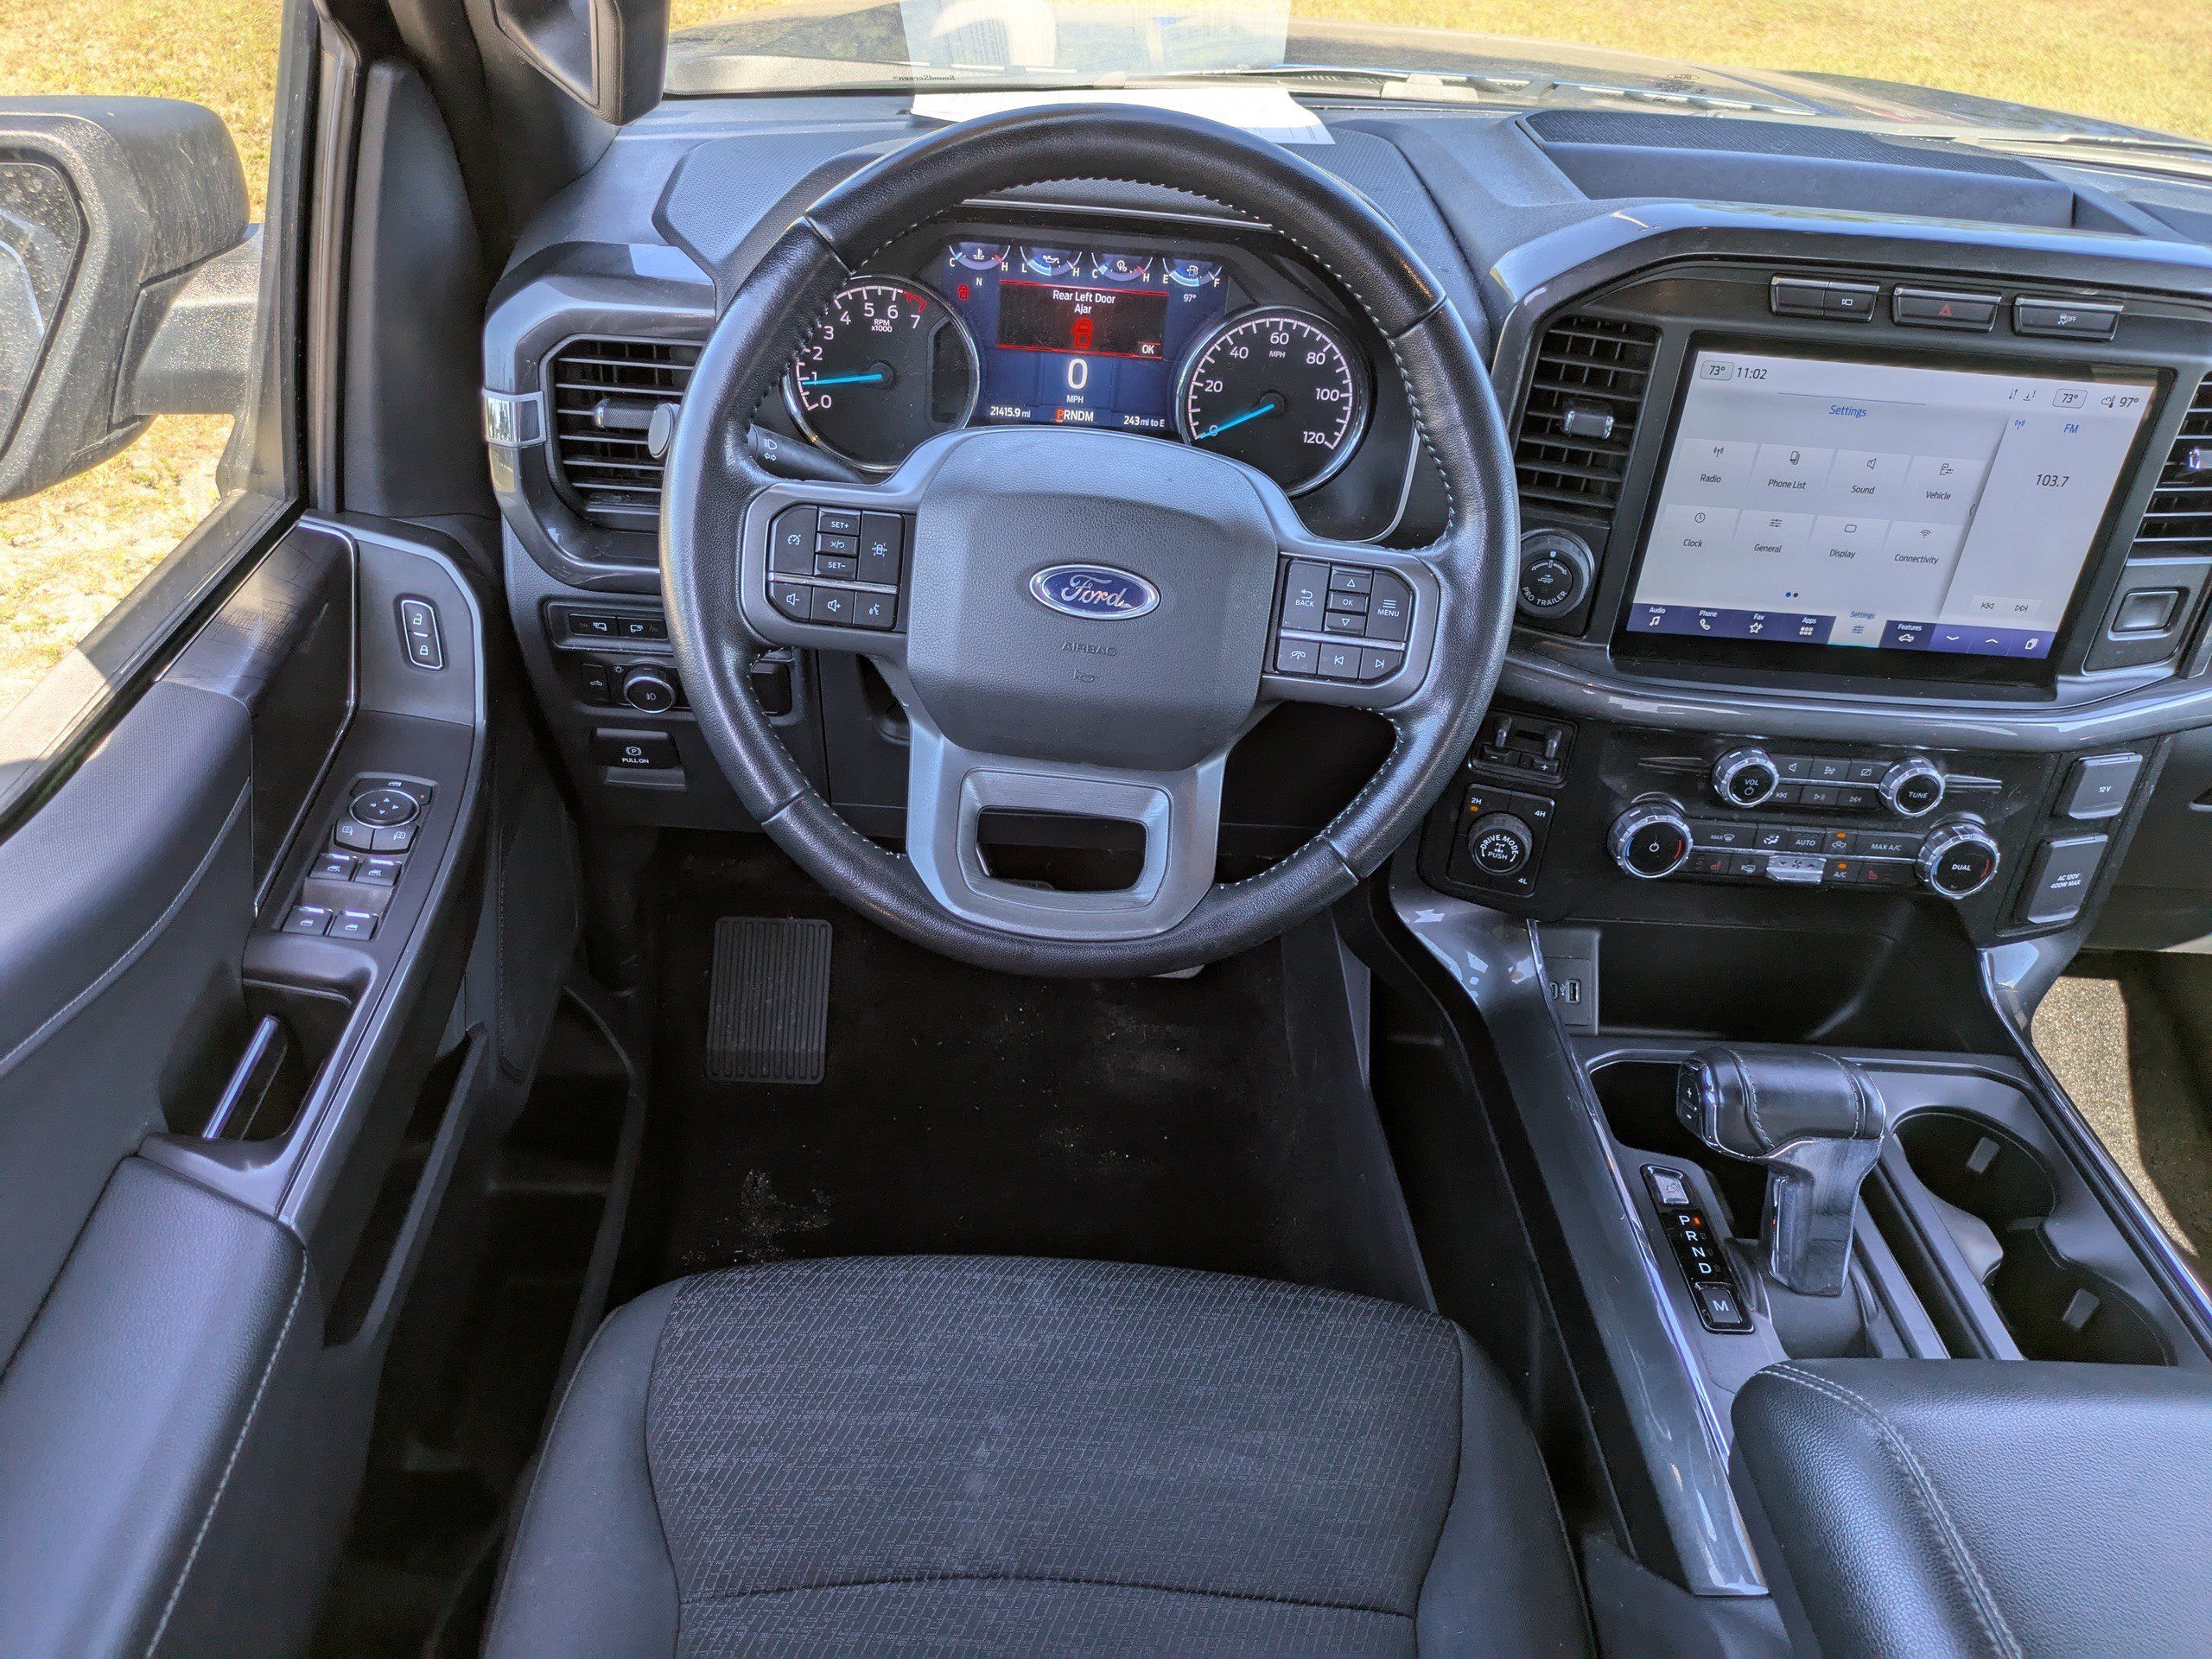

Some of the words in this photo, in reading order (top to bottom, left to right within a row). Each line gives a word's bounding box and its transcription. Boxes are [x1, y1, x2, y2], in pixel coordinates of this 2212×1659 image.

[950, 258, 956, 268] C
[1001, 263, 1008, 272] H
[1021, 264, 1027, 273] L
[1072, 268, 1080, 277] H
[1092, 270, 1098, 279] C
[1143, 273, 1150, 283] H
[976, 277, 982, 286] N
[1163, 275, 1168, 284] E
[1214, 278, 1220, 288] F
[1052, 289, 1073, 302] Rear
[1075, 291, 1093, 302] Left
[1095, 293, 1116, 304] Door
[864, 302, 874, 317] 5
[887, 305, 899, 320] 6
[1074, 304, 1092, 315] Ajar
[840, 310, 852, 326] 4
[874, 318, 891, 327] RPM
[910, 315, 921, 329] 7
[823, 326, 835, 340] 3
[1270, 333, 1289, 345] 60
[812, 346, 823, 360] 2
[1141, 344, 1154, 354] OK
[1230, 346, 1249, 359] 40
[1306, 353, 1326, 365] 80
[811, 372, 818, 385] 1
[1067, 358, 1089, 390] 0
[1737, 367, 1767, 380] 11:02
[1205, 380, 1224, 393] 20
[1066, 395, 1084, 404] MPH
[1315, 388, 1340, 402] 100
[821, 395, 832, 409] 0
[990, 406, 1020, 418] 21415.9
[1021, 410, 1031, 418] mi
[1829, 404, 1867, 417] Settings
[1123, 415, 1140, 426] 243
[1140, 417, 1149, 427] mi
[1150, 418, 1159, 427] to
[1159, 418, 1165, 428] E
[2063, 423, 2080, 434] FM
[1302, 431, 1325, 444] 120
[1700, 474, 1722, 484] Radio
[1768, 479, 1791, 489] Phone
[1792, 480, 1807, 490] List
[2035, 474, 2070, 488] 103.7
[1851, 485, 1875, 495] Sound
[1925, 490, 1952, 501] Vehicle
[1683, 538, 1703, 548] Clock
[1754, 543, 1783, 554] General
[1829, 549, 1856, 559] Display
[1894, 553, 1938, 564] Connectivity
[1062, 574, 1134, 609] Ford
[1522, 587, 1535, 601] PRO
[1537, 590, 1567, 606] TRAILER
[1377, 608, 1400, 618] MENU
[1850, 611, 1875, 620] Settings
[1802, 616, 1817, 625] Apps
[1061, 641, 1117, 657] AIRBAG
[1471, 797, 1482, 805] 2H
[1480, 835, 1501, 849] DRIVE
[1502, 836, 1519, 855] MODE
[1488, 851, 1508, 861] PUSH
[1679, 1215, 1690, 1225] P
[1686, 1230, 1697, 1241] R
[1692, 1247, 1706, 1257] N
[1699, 1262, 1712, 1274] D
[1713, 1300, 1729, 1311] M
